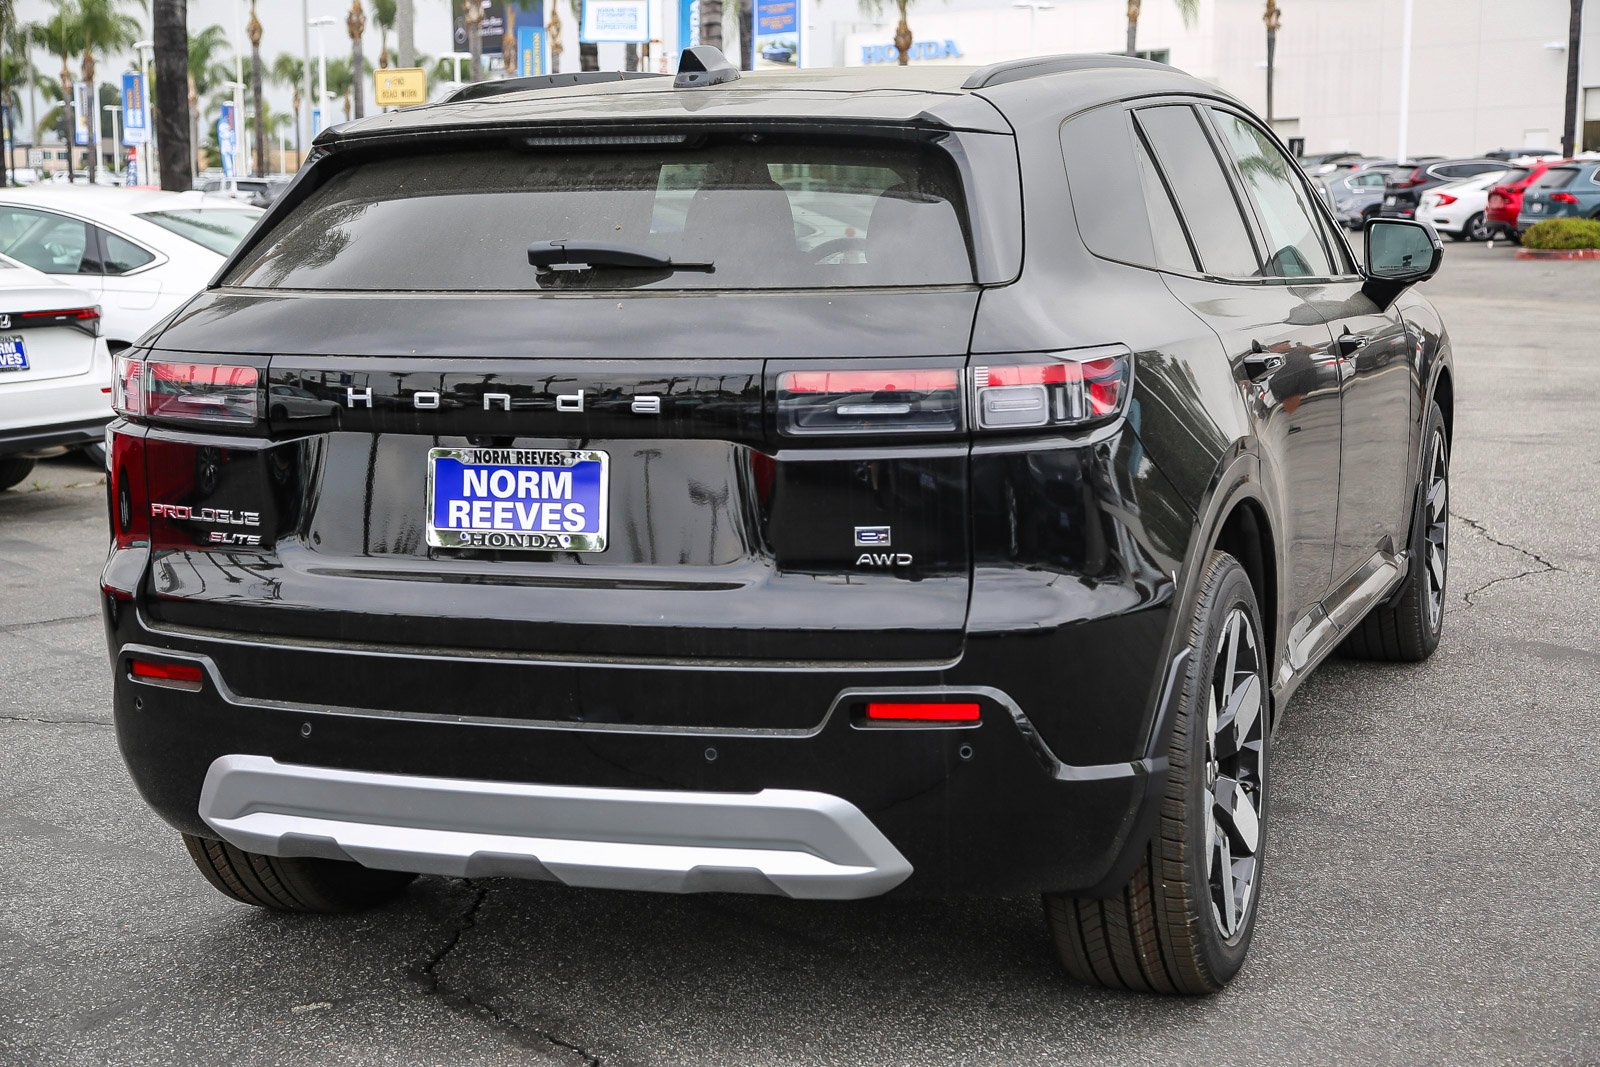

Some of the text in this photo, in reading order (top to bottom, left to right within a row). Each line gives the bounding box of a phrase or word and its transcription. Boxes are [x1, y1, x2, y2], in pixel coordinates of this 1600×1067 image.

[0, 342, 17, 353] RM
[0, 353, 23, 365] VES
[473, 450, 560, 466] NORM REEVES
[462, 469, 573, 500] NORM
[151, 503, 261, 527] PROLOGUE
[448, 500, 587, 532] REEVES
[208, 531, 262, 545] ELITE
[468, 532, 564, 549] HONDA
[855, 553, 913, 566] AWD
